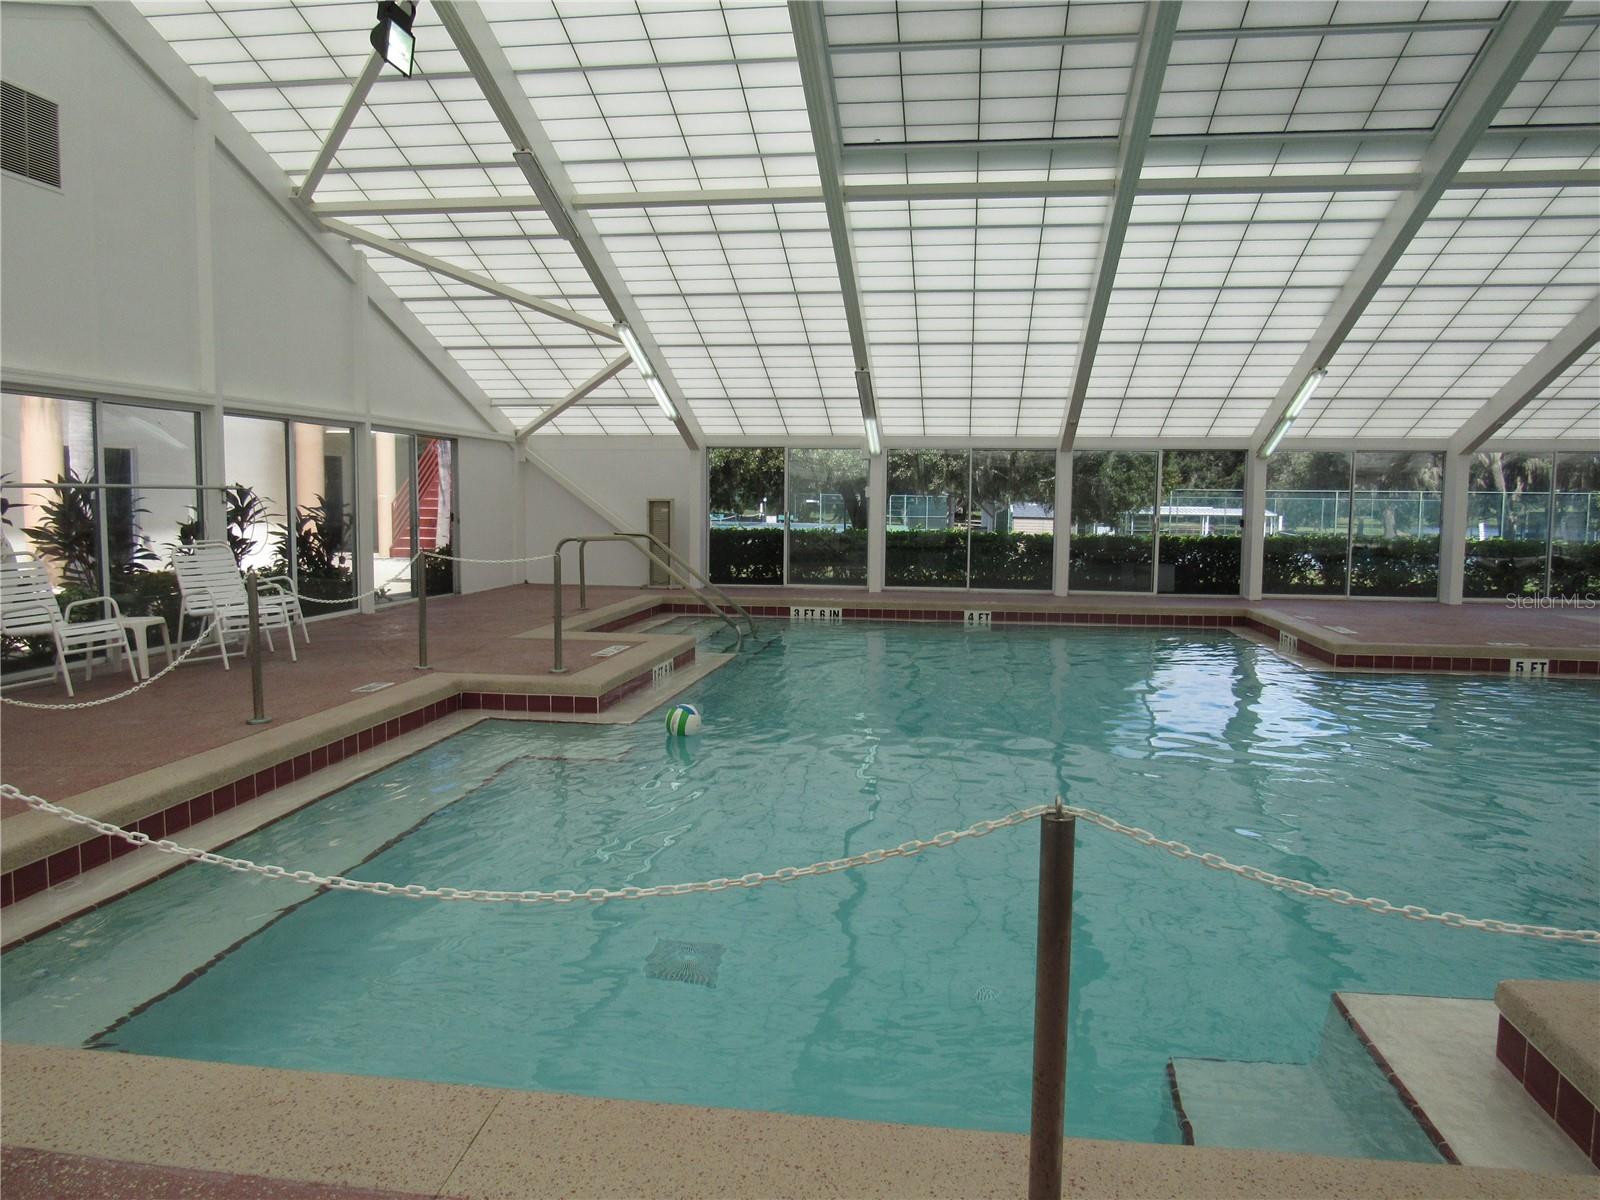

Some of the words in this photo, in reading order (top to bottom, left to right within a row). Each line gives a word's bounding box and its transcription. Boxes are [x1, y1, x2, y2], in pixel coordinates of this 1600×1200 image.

[804, 609, 815, 618] FT
[829, 609, 840, 618] IN
[967, 612, 974, 621] 4
[978, 612, 990, 621] FT
[1516, 662, 1524, 672] 5
[1531, 662, 1547, 672] FT
